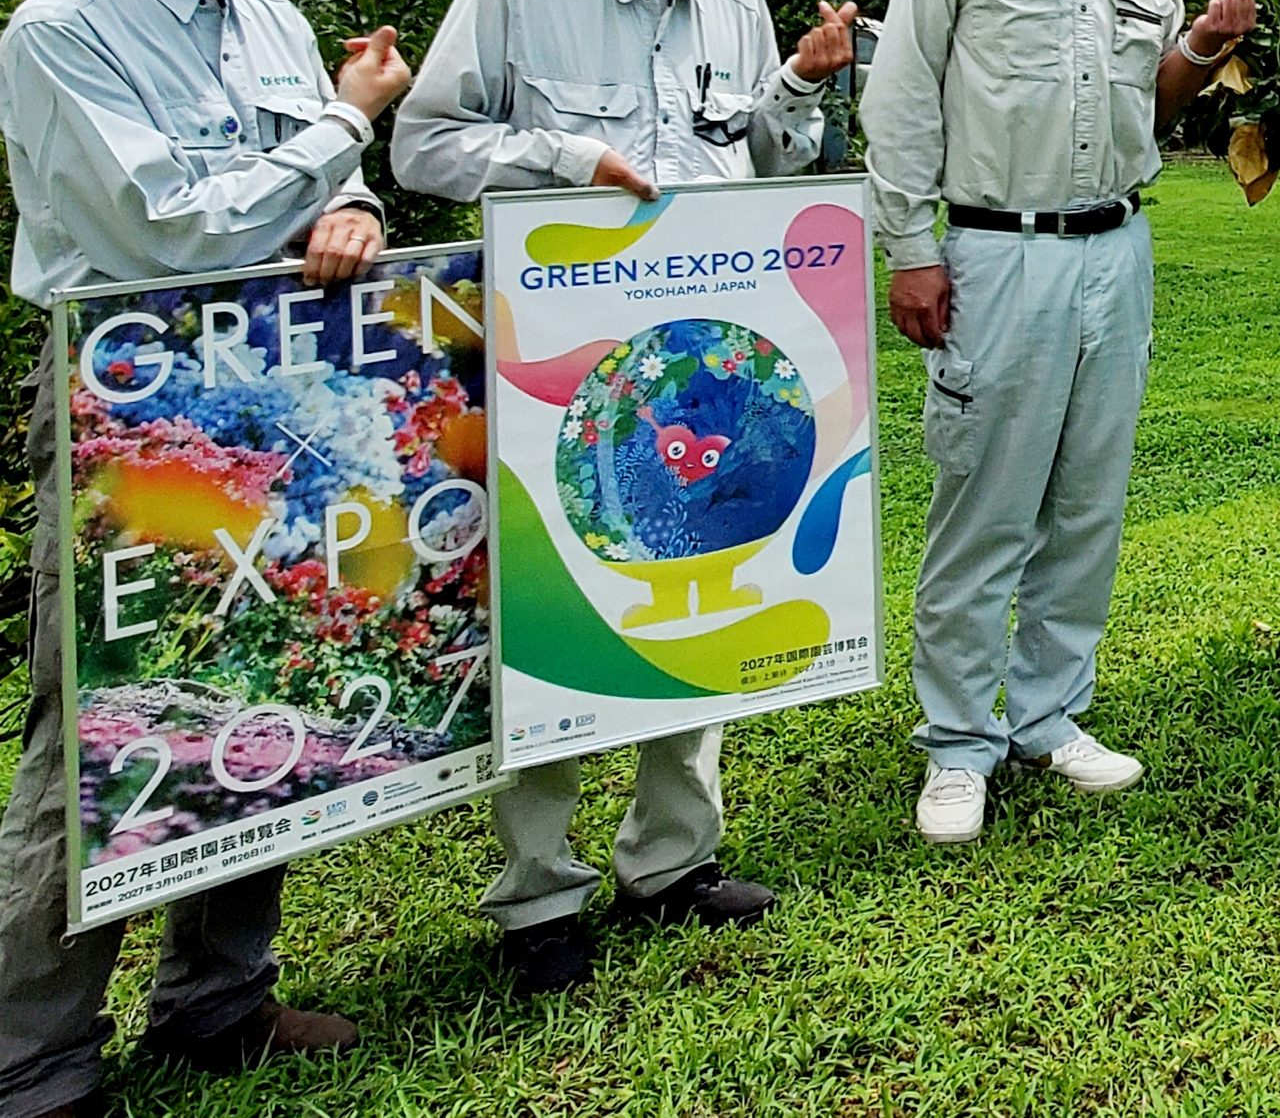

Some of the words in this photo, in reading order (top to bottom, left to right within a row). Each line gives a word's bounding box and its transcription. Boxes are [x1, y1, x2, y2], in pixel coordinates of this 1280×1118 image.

[623, 284, 708, 301] YOKOHAMA
[712, 279, 757, 294] JAPAN
[762, 243, 846, 273] 2027
[103, 478, 489, 640] EXPO
[109, 644, 489, 836] 2027
[85, 817, 292, 897] 2027年国際園芸博覧会
